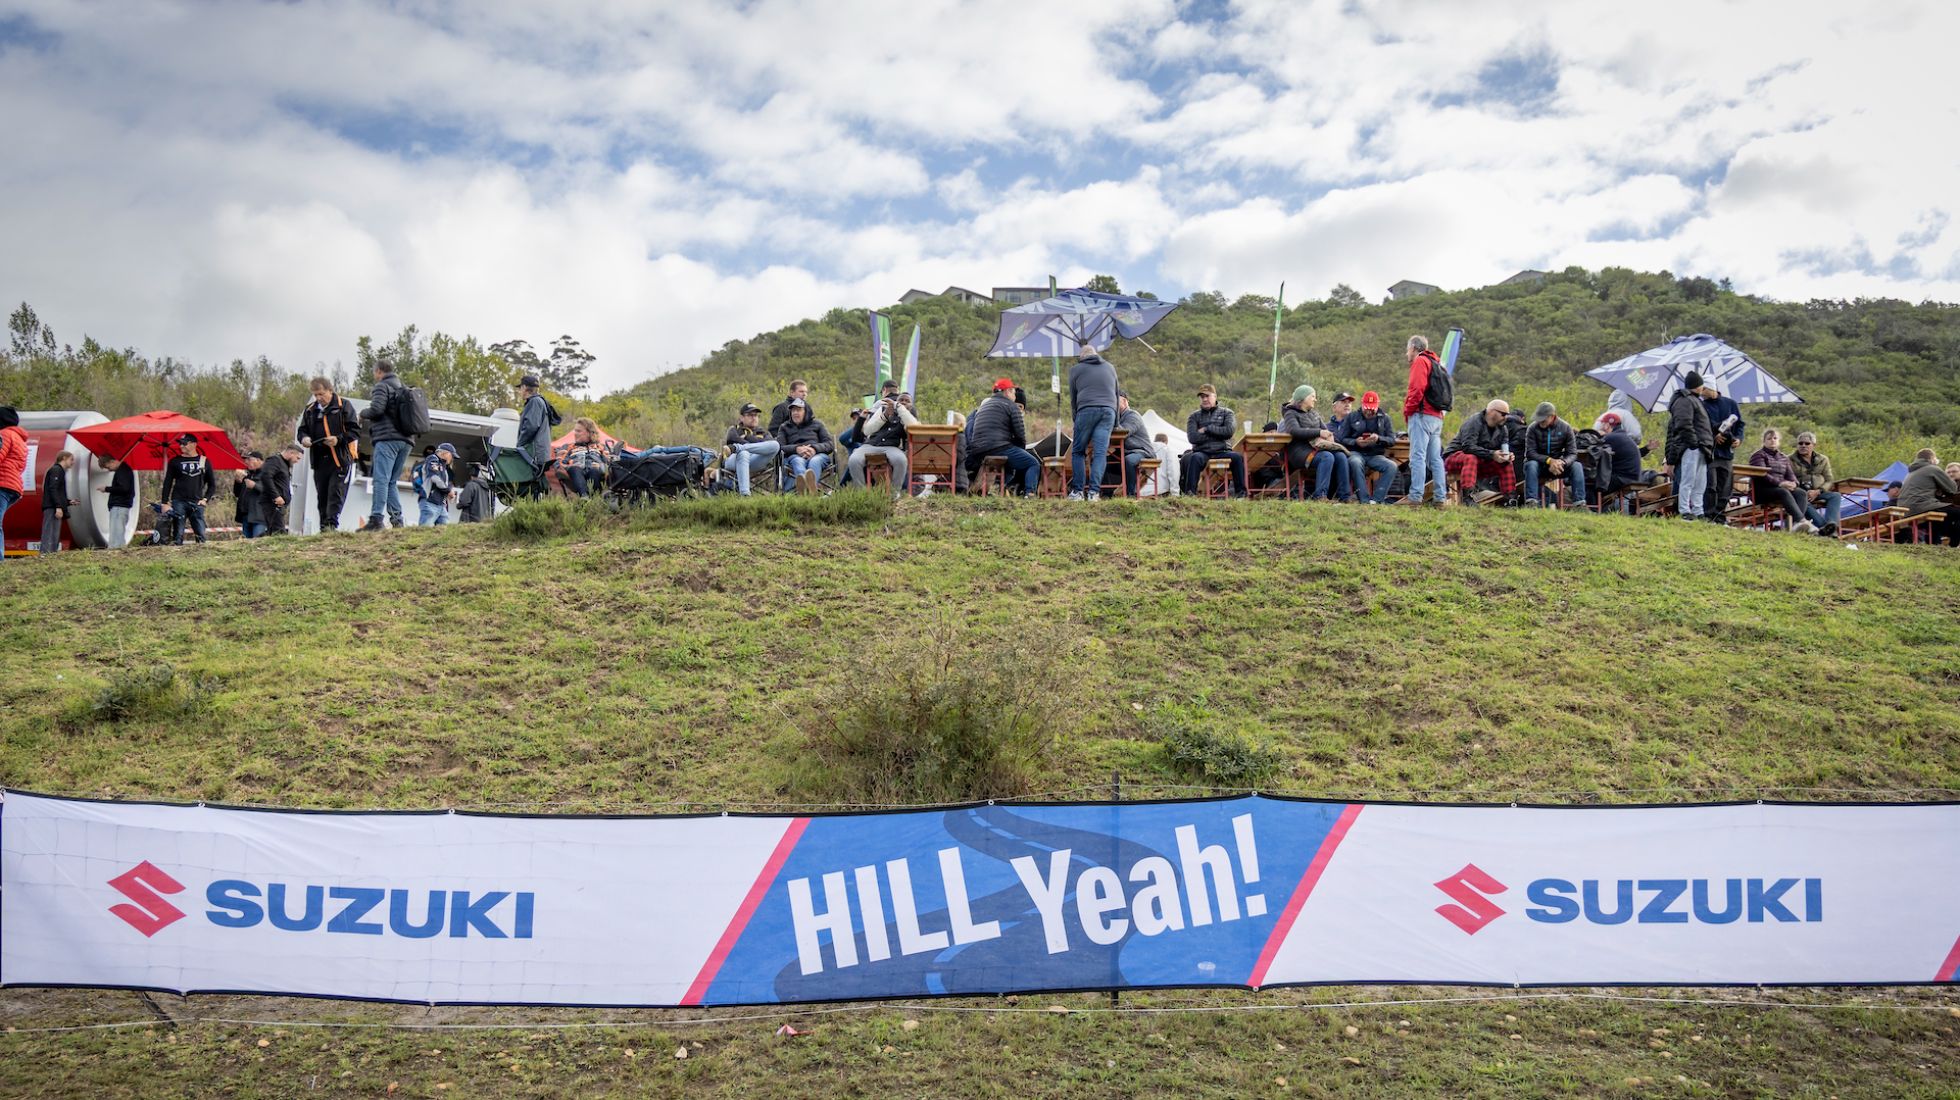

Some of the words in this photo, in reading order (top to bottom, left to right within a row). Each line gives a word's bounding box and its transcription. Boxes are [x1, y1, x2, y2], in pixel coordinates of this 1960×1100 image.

[206, 879, 535, 939] SUZUKI
[787, 846, 1001, 976] HILL
[1009, 812, 1268, 955] Yeah!
[1525, 877, 1823, 925] SUZUKI
